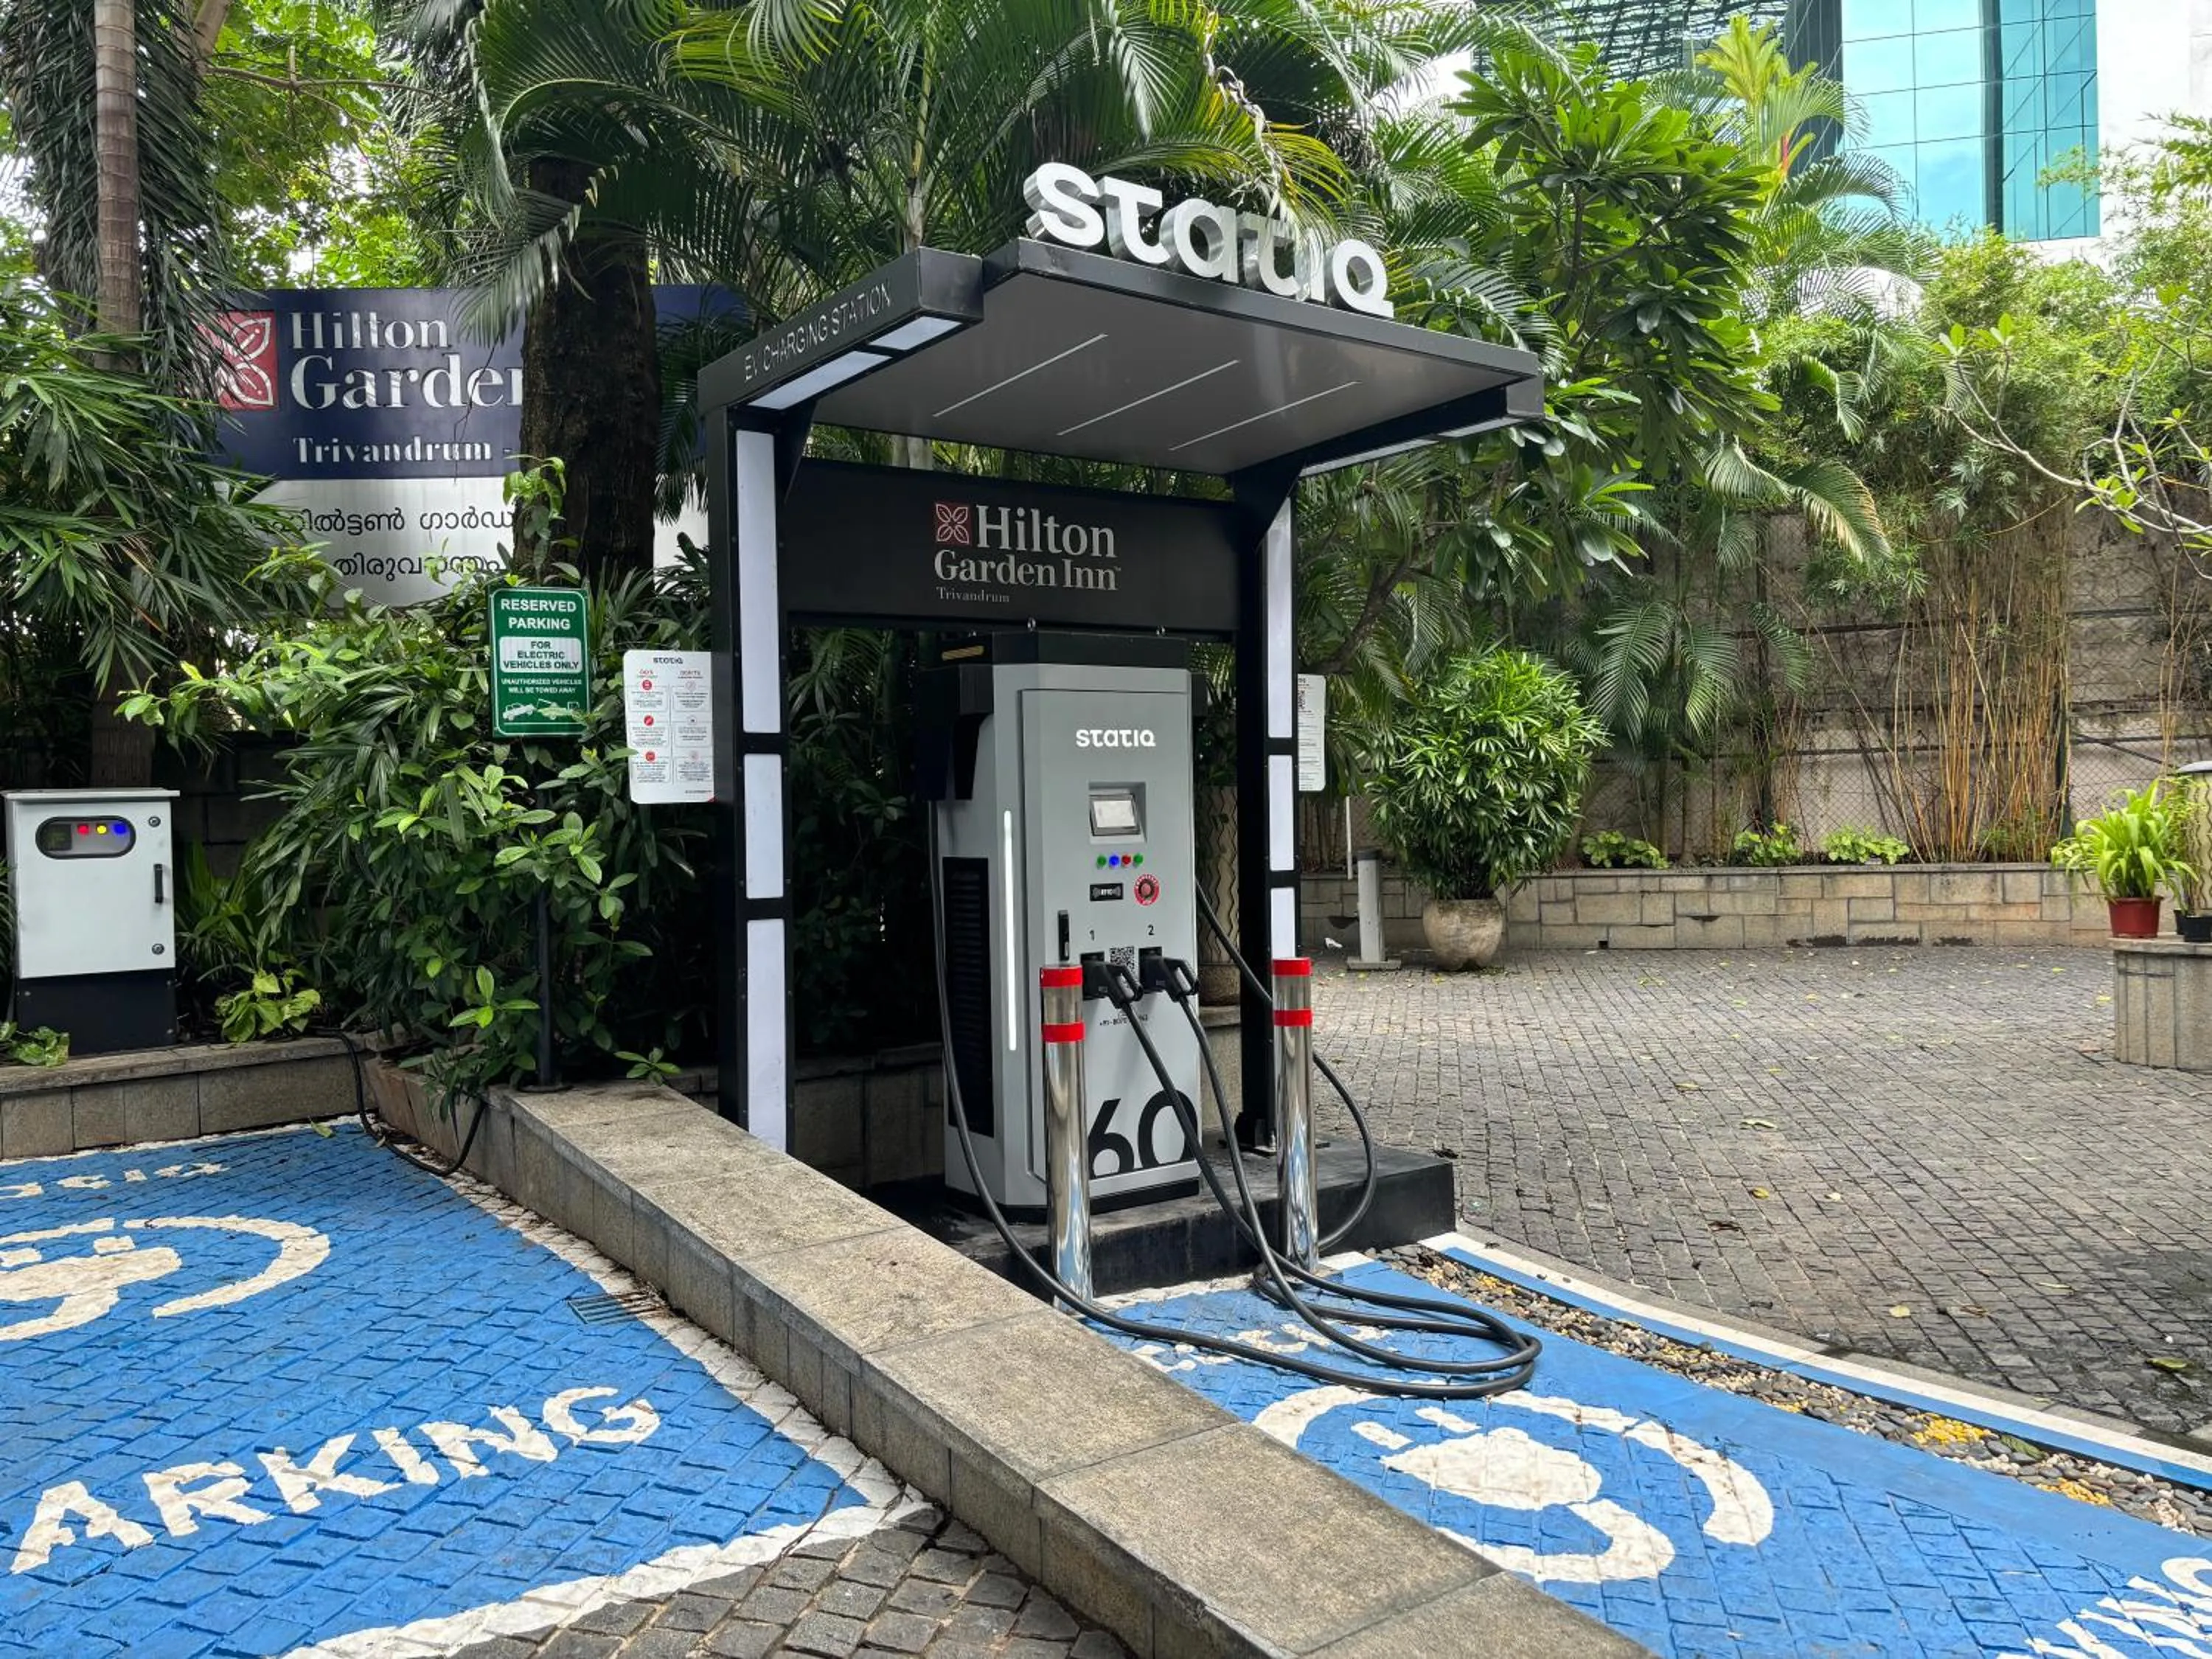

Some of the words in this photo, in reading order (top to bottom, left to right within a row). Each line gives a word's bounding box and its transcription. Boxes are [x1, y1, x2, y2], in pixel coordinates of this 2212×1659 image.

[291, 311, 452, 349] Hilton
[745, 353, 762, 381] EV
[762, 313, 828, 372] CHARGING
[830, 279, 891, 336] STATION
[293, 436, 493, 463] Trivandrum
[975, 504, 1118, 558] Hilton
[933, 549, 1057, 588] Garden
[936, 586, 1010, 603] Trivandrum
[501, 598, 577, 613] RESERVED
[508, 616, 571, 630] PARKING
[530, 640, 552, 650] FOR
[517, 650, 566, 660] ELECTRIC
[503, 660, 552, 669] VEHICLES
[554, 661, 580, 670] ONLY
[1147, 924, 1155, 936] 2
[1088, 1089, 1199, 1180] 60
